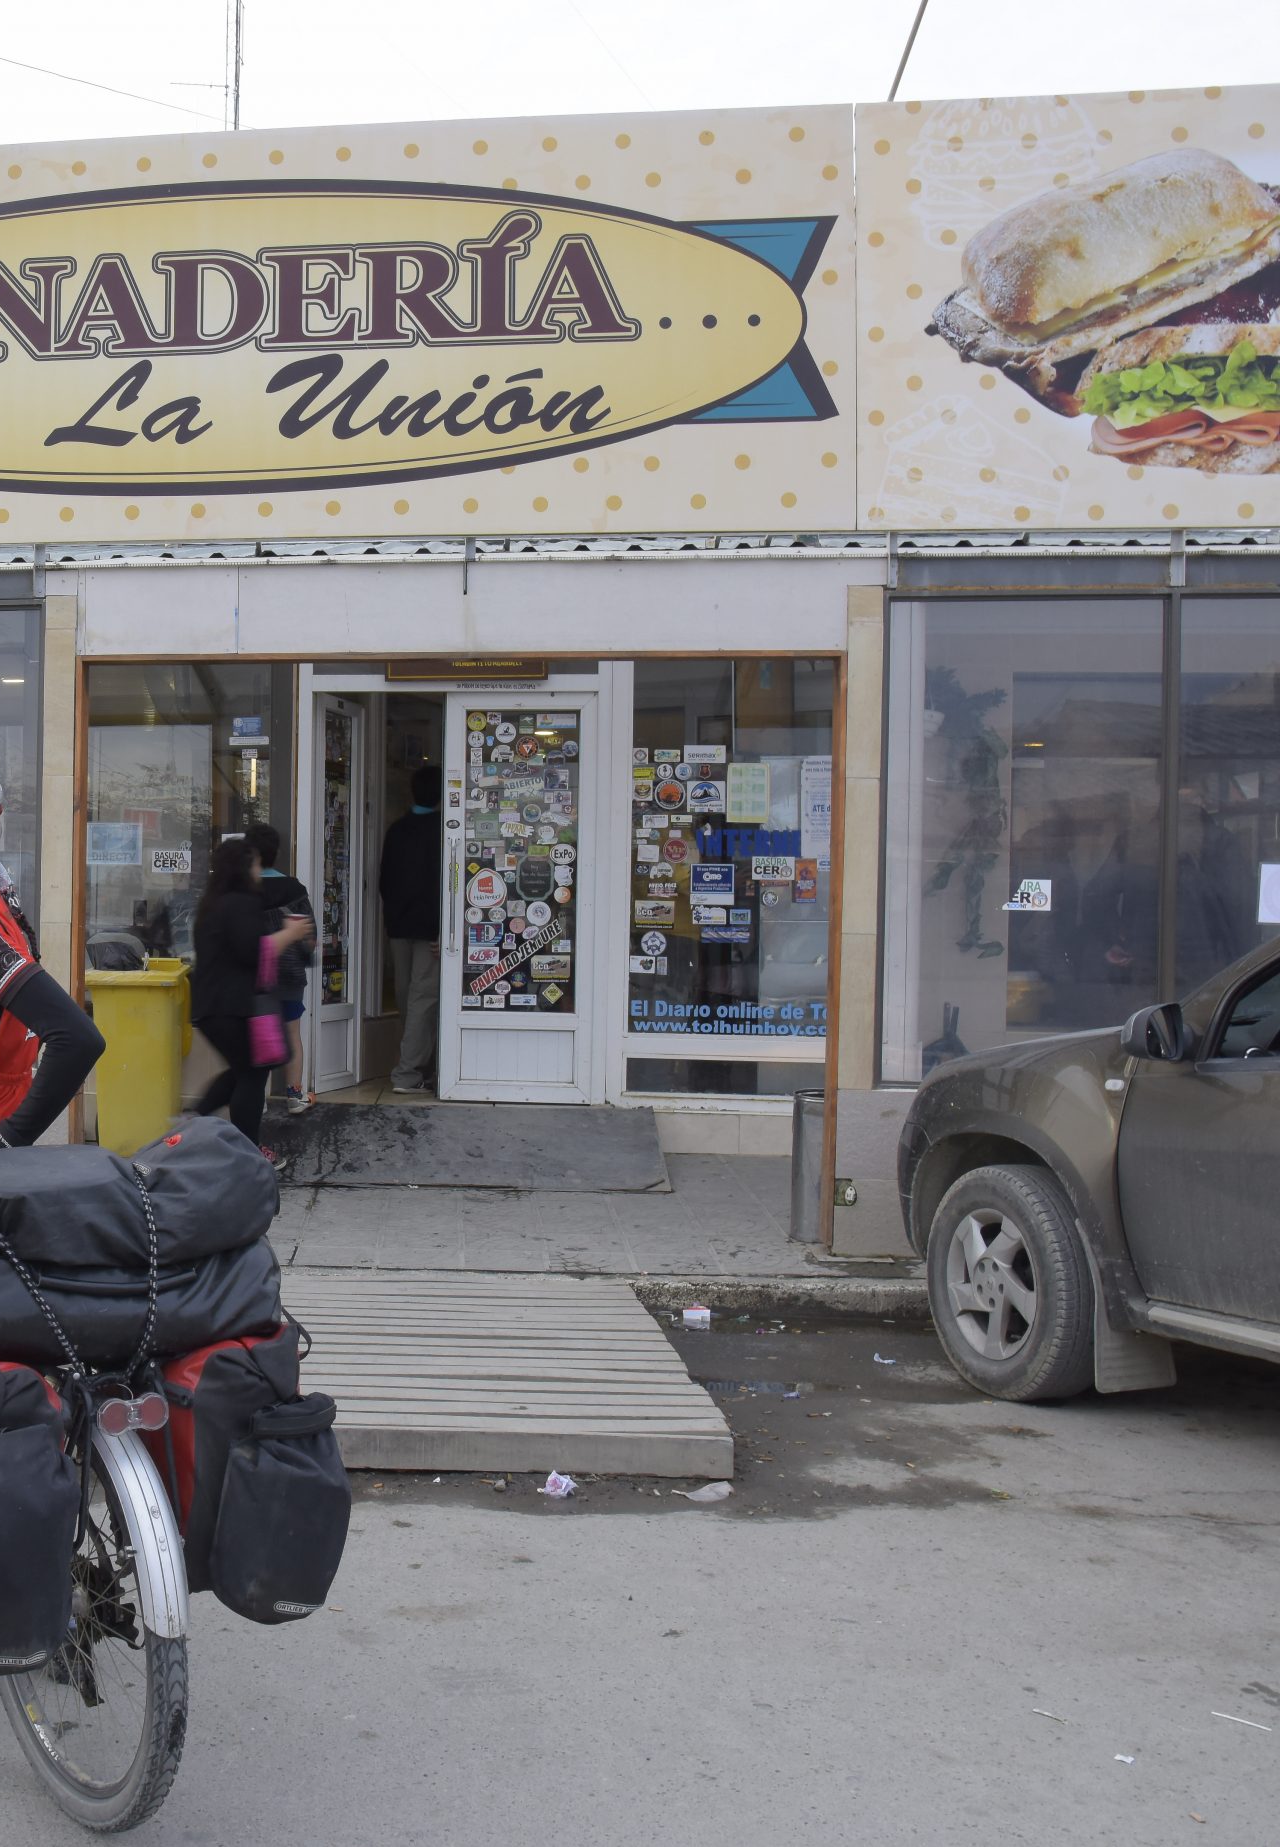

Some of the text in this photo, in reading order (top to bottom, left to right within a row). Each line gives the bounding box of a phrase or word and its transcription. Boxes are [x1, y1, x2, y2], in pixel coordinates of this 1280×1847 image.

[43, 353, 612, 447] La Unión
[154, 851, 185, 860] BASURA
[554, 849, 573, 859] ExPo
[756, 857, 788, 866] BASURA
[631, 1000, 648, 1016] El
[655, 1000, 711, 1018] Diario
[717, 1003, 774, 1020] online
[781, 1004, 804, 1020] de
